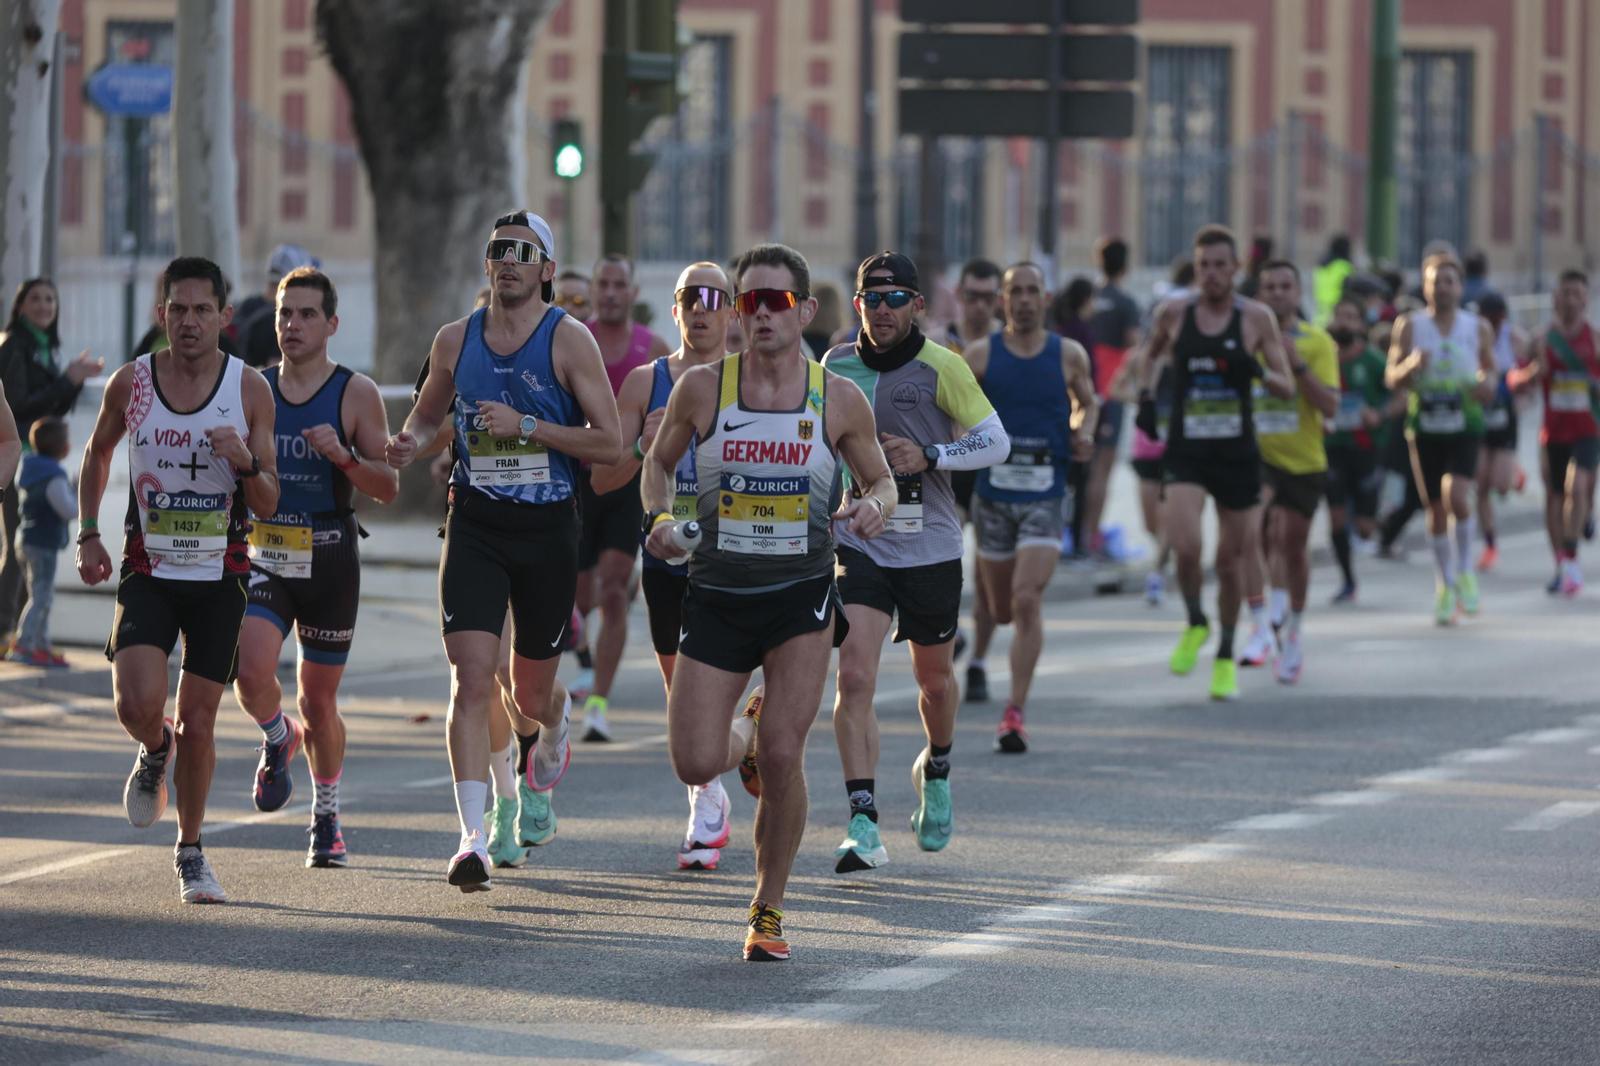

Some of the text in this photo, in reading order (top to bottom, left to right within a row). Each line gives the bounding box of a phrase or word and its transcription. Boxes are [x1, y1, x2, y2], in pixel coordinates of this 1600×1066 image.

[155, 428, 191, 448] VIDA
[495, 440, 516, 451] 916
[722, 440, 813, 466] GERMANY
[157, 458, 174, 470] en
[495, 458, 519, 468] FRAN
[748, 481, 799, 492] ZURICH
[173, 497, 218, 508] ZURICH
[752, 505, 775, 517] 704
[173, 520, 201, 532] 1437
[752, 525, 774, 535] TOM
[172, 539, 200, 548] DAVID
[266, 533, 283, 545] 790
[261, 550, 288, 561] MALPU
